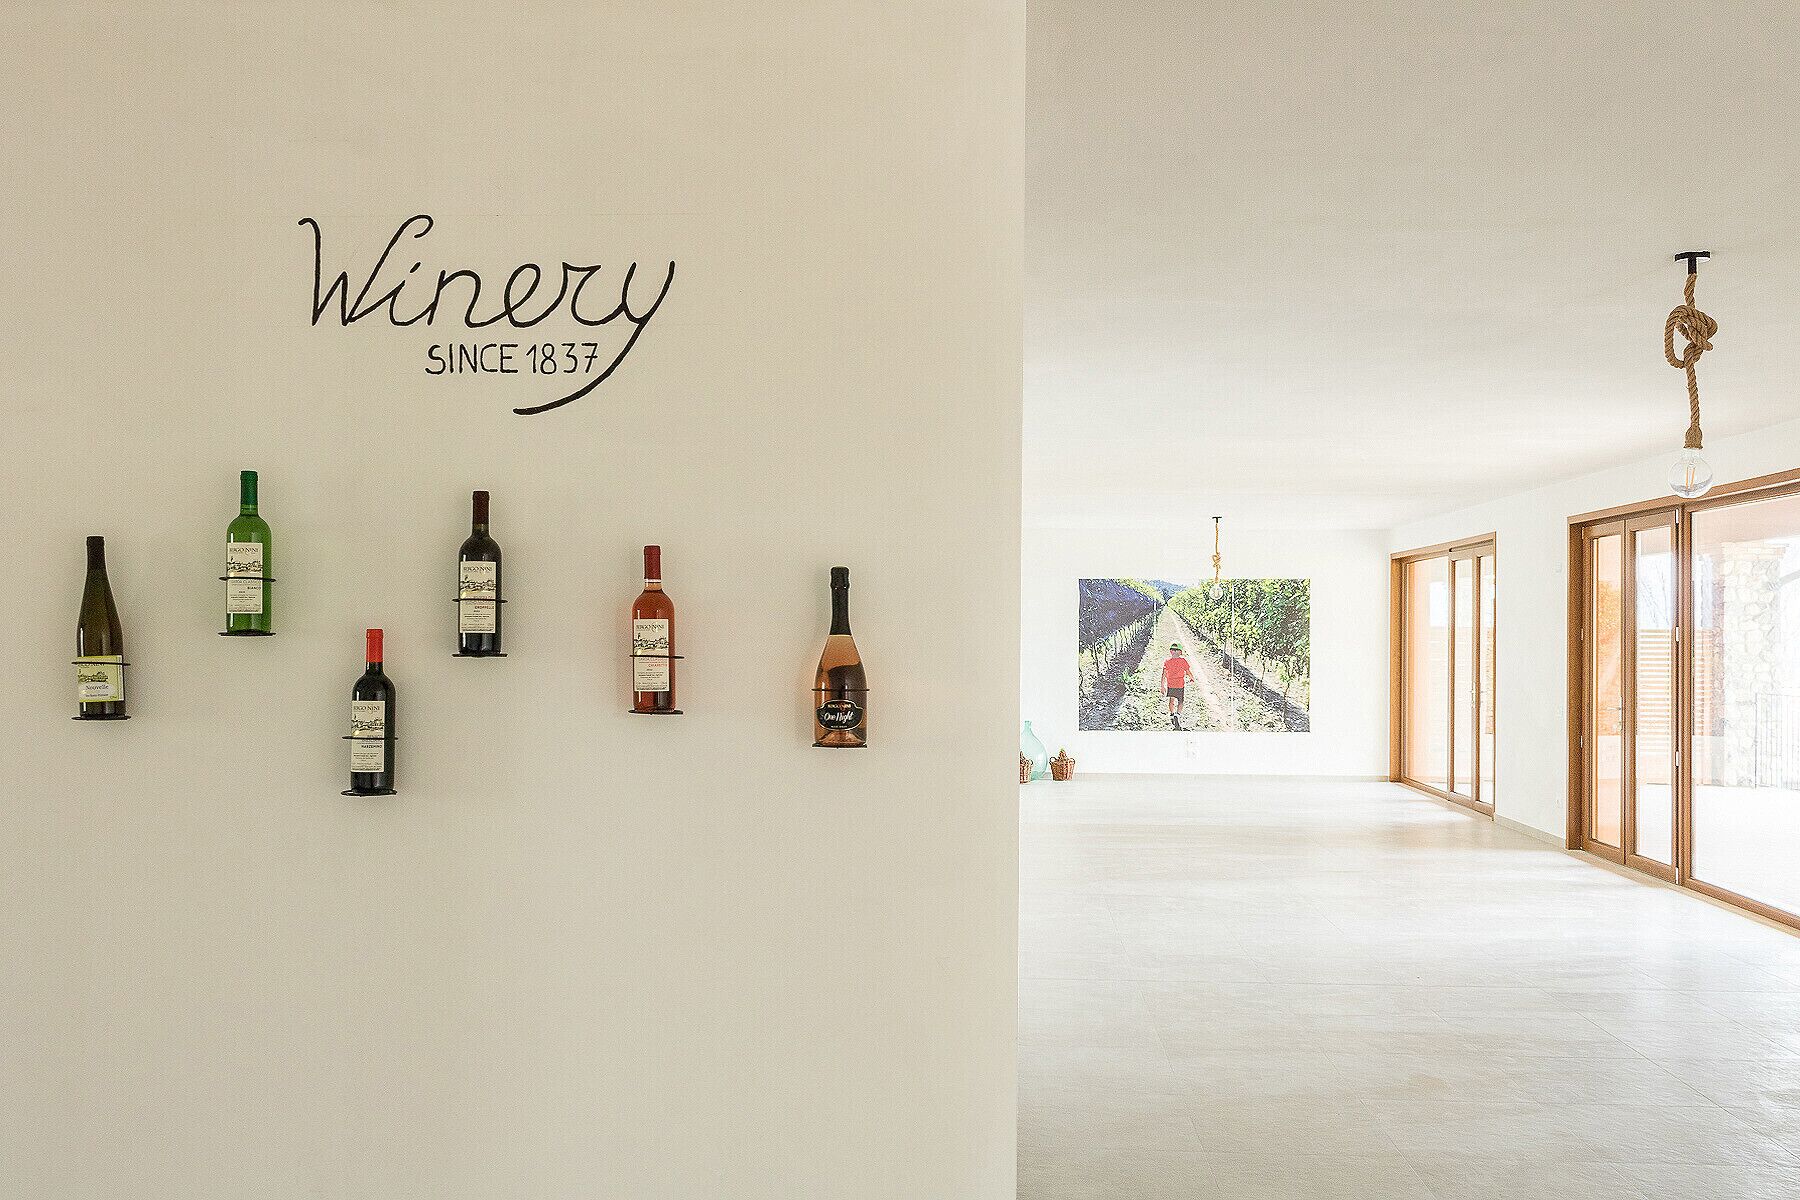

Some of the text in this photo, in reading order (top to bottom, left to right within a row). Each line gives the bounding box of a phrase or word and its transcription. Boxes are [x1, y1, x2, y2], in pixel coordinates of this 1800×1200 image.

[298, 214, 675, 416] Winery
[425, 343, 599, 374] SINCE 1837
